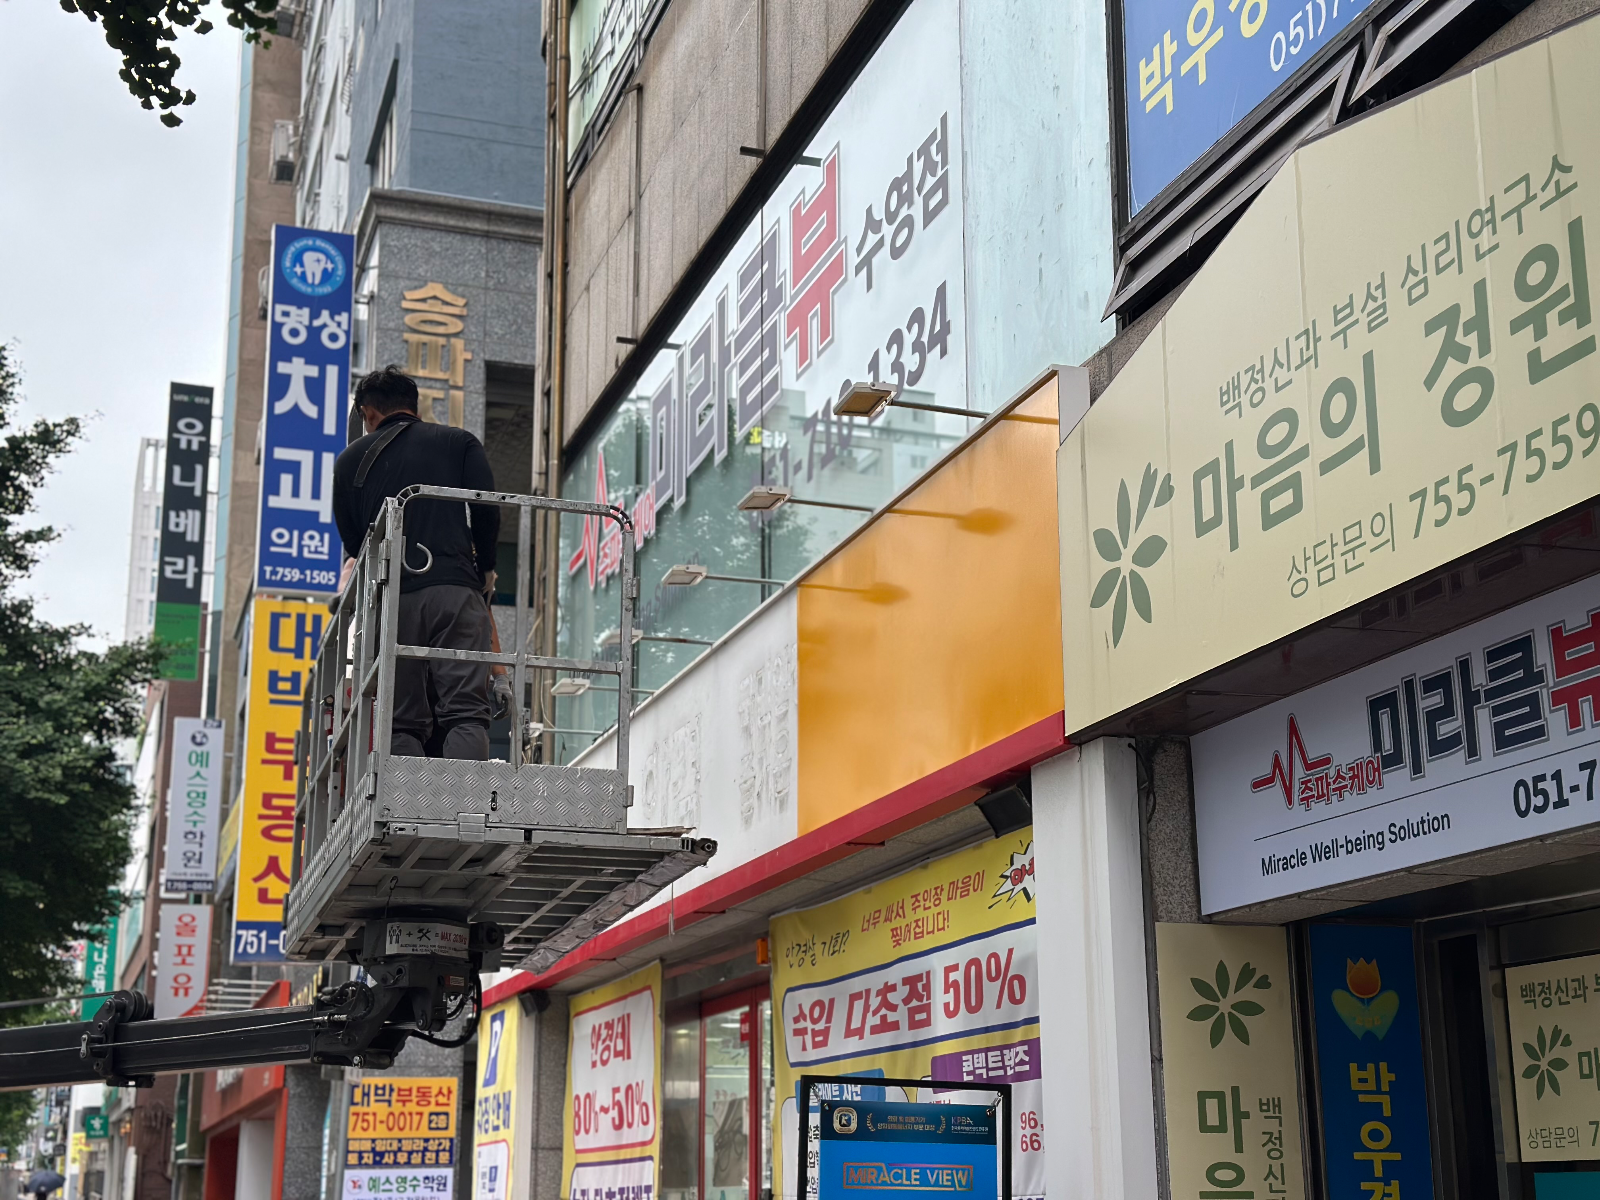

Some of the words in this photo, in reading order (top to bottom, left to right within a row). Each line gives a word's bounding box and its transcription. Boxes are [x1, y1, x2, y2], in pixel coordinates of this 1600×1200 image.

[855, 111, 949, 293] 수영점
[274, 303, 348, 350] 명성
[650, 140, 847, 512] 미라클뷰
[1219, 318, 1321, 418] 백정신과
[1331, 272, 1388, 349] 부설
[1400, 154, 1578, 306] 심리연구소
[1193, 350, 1381, 552] 마음의
[1423, 215, 1596, 428] 정원
[267, 356, 339, 525] 치과
[163, 417, 207, 589] 유니베라
[597, 483, 656, 587] 주파케어
[1286, 502, 1396, 599] 상담문의
[1408, 402, 1600, 540] 755-7559
[263, 564, 336, 587] T.759-1505
[269, 527, 331, 561] 의원
[1366, 606, 1600, 782] 미라클뷰
[182, 749, 210, 869] 예스영수학원
[1297, 753, 1385, 812] 주파수케어
[1261, 848, 1308, 878] Miracle
[1310, 829, 1386, 865] Well-being
[1388, 811, 1451, 846] Solution
[861, 908, 882, 933] 너무
[883, 897, 906, 926] 싸서
[910, 884, 944, 914] 주인장
[947, 869, 985, 902] 마음이
[890, 909, 950, 949] 찢어집니다!
[170, 914, 198, 998] 올포유
[1520, 974, 1588, 1008] 백정신과
[591, 1013, 632, 1069] 안경태
[792, 997, 836, 1052] 수입
[843, 969, 932, 1041] 다초점
[943, 947, 1027, 1020] 50%
[351, 1111, 425, 1132] 751-0017
[1258, 1095, 1288, 1200] 백정신
[1527, 1124, 1580, 1149] 상담문의
[848, 1167, 920, 1187] MIRACLE
[927, 1168, 970, 1191] VIEW
